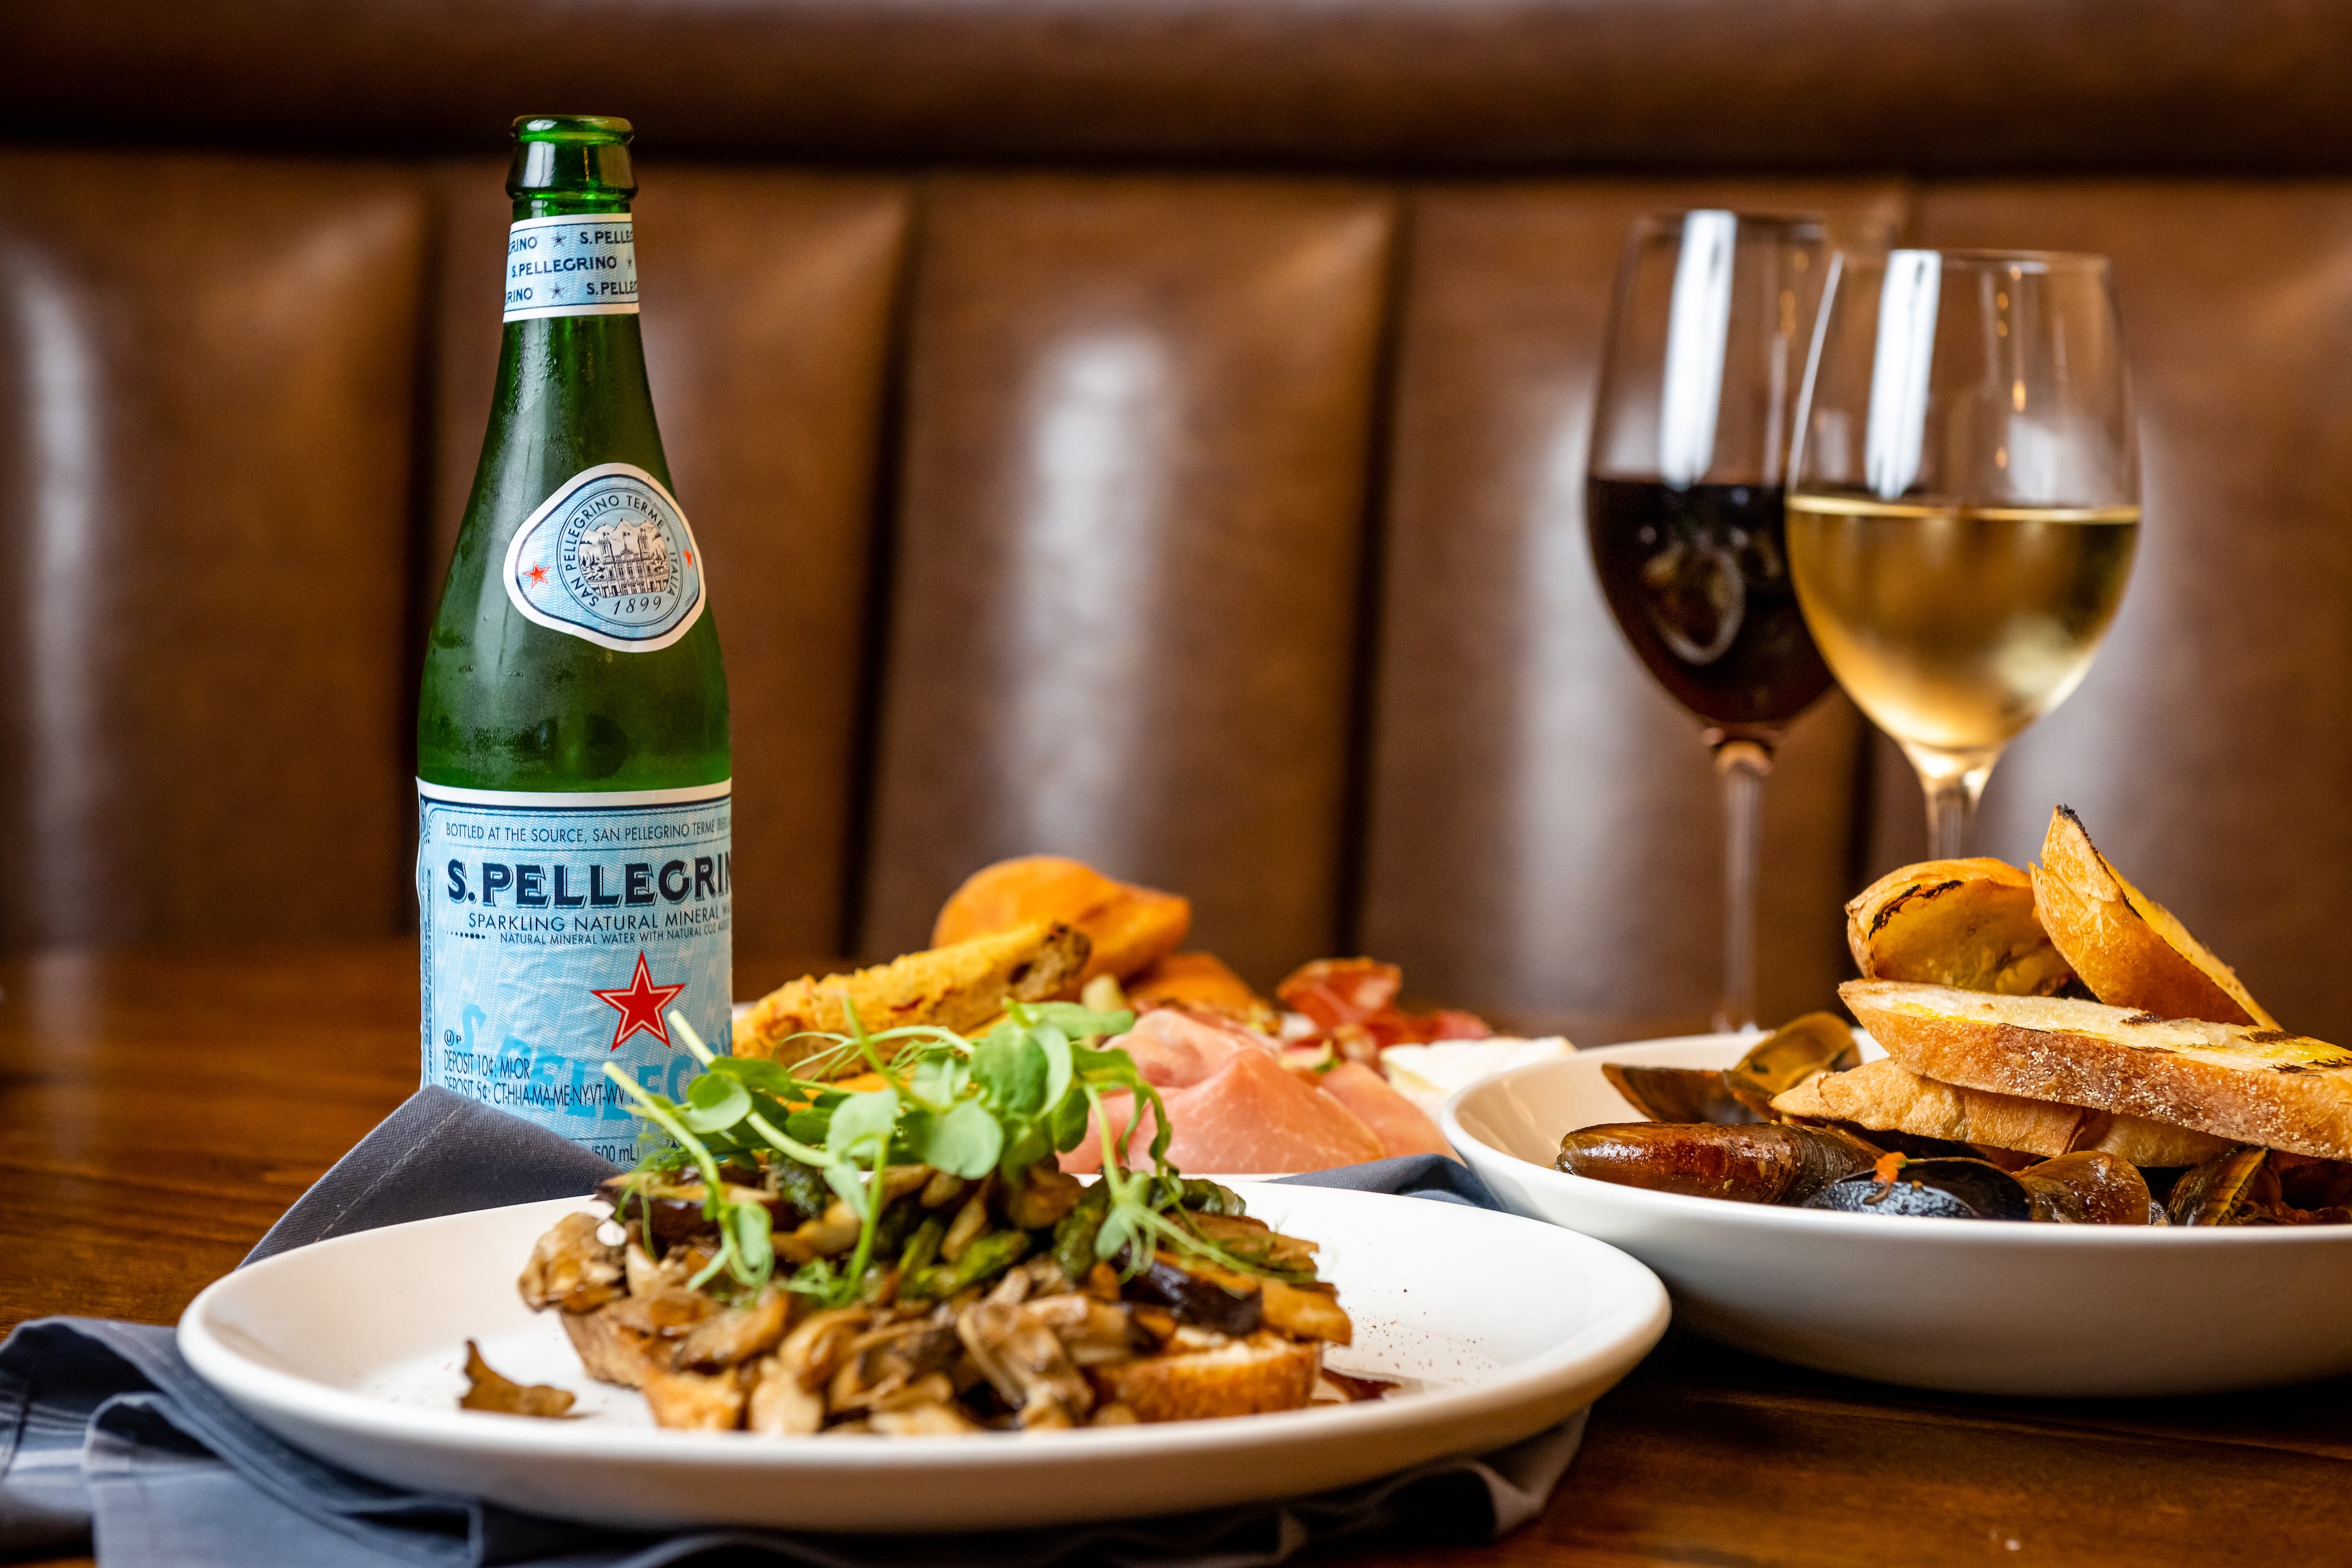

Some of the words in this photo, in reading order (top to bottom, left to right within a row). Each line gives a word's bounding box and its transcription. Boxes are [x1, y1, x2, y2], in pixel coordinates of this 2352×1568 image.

[512, 255, 617, 277] S.PELLEGRINO
[626, 495, 663, 530] TERME
[564, 495, 619, 571] PELLEGRINO
[667, 552, 676, 596] ITALIA
[573, 577, 599, 606] SAN
[613, 596, 662, 616] 1899
[446, 822, 484, 839] BOTTLED
[488, 827, 500, 840] AT
[505, 827, 526, 842] THE
[532, 828, 587, 844] SOURCE,
[593, 828, 619, 842] SAN
[625, 823, 689, 840] PELLEGRINO
[692, 820, 715, 835] TERME
[469, 913, 565, 932] SPARKLING
[575, 913, 658, 932] NATURAL
[665, 905, 719, 927] MINERAL
[500, 933, 546, 944] NATURAL
[550, 933, 597, 944] MINERAL
[601, 932, 635, 944] WATER
[639, 930, 663, 942] WITH
[667, 925, 702, 940] NATURAL
[444, 1049, 474, 1076] DEPOSIT
[500, 1055, 530, 1079] MI-OR
[592, 1145, 616, 1163] 500
